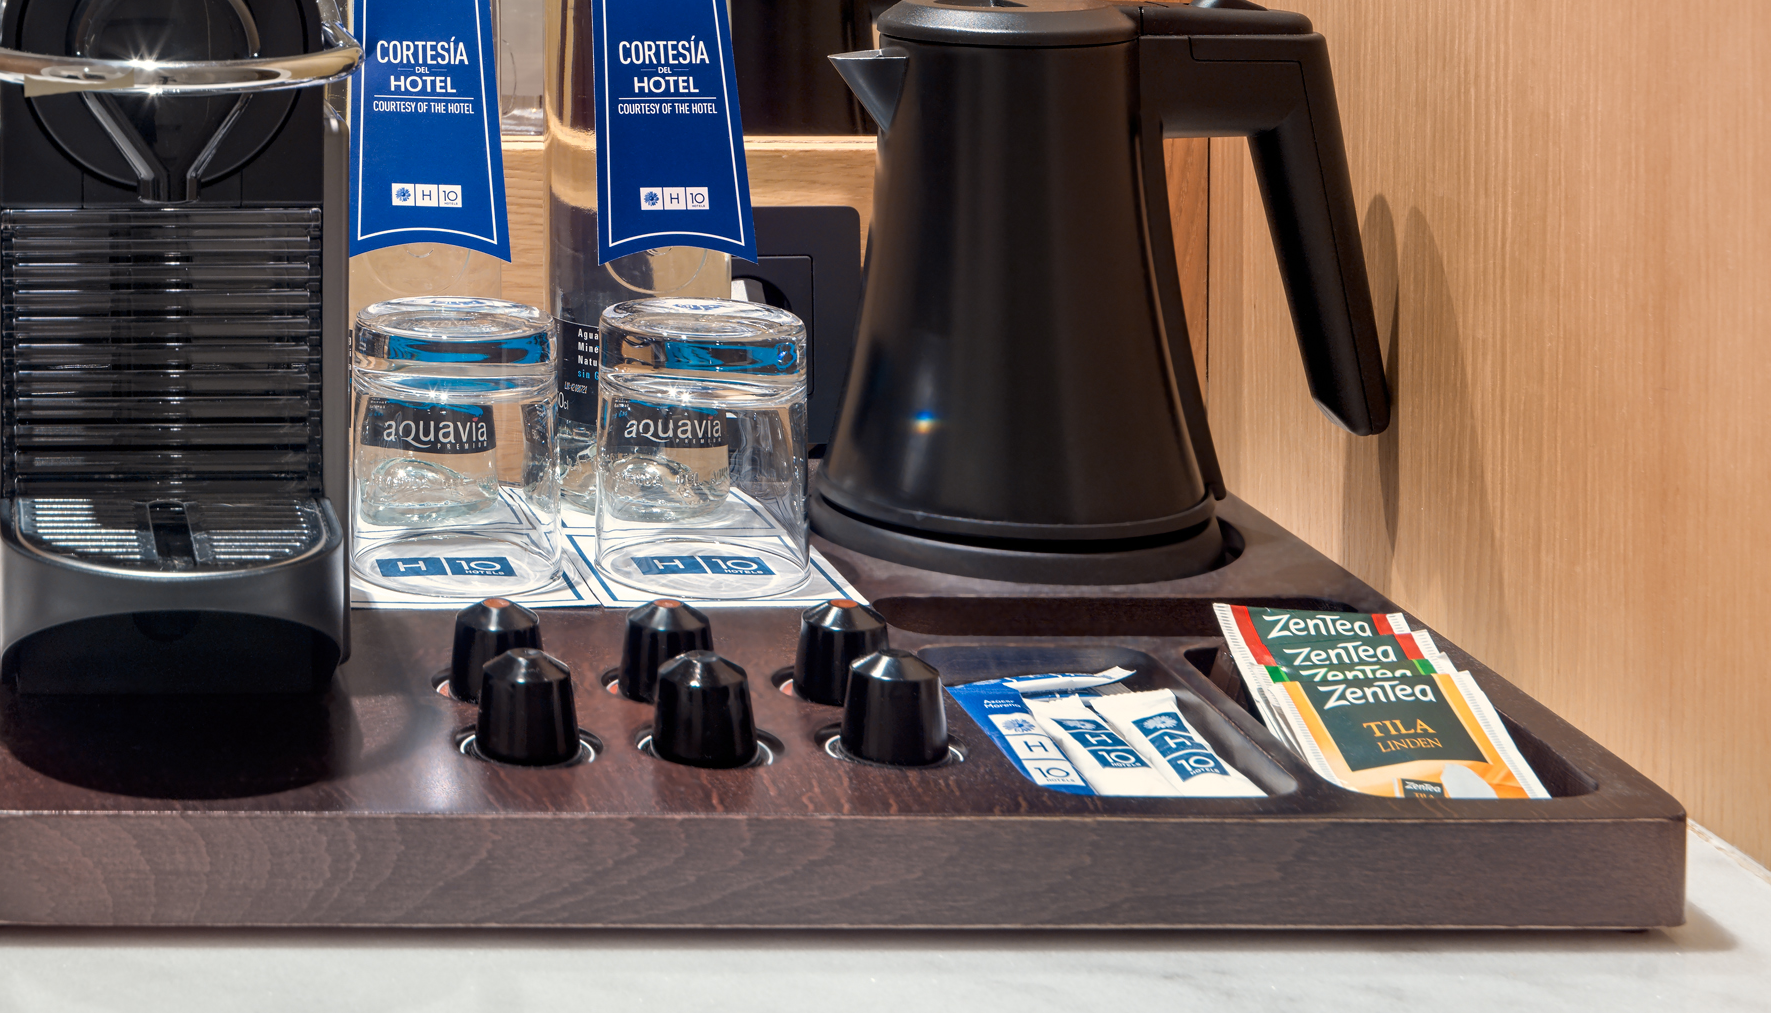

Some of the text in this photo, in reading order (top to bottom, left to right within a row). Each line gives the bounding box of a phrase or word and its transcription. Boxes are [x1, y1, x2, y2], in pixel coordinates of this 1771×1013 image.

[376, 36, 469, 65] CORTESÍA
[618, 35, 710, 64] CORTESÍA
[390, 75, 457, 93] HOTEL
[633, 76, 700, 93] HOTEL
[373, 100, 475, 115] COURTESY OF THE HOTEL
[618, 103, 718, 115] COURTESY OF THE HOTEL
[422, 189, 459, 202] H 10
[669, 192, 706, 205] H 10
[577, 328, 599, 341] Agua
[577, 341, 599, 354] Mine
[577, 354, 598, 367] Natu
[577, 369, 591, 379] sin
[396, 560, 502, 572] H 10
[653, 558, 758, 571] H 10
[1262, 614, 1373, 639] ZenTea
[1283, 641, 1398, 666] ZenTea
[1317, 680, 1437, 710] ZenTea
[1362, 718, 1437, 737] TILA
[1085, 733, 1113, 745] H
[1164, 735, 1192, 749] H
[1377, 737, 1443, 753] LINDEN
[1023, 740, 1049, 753] H
[1098, 751, 1136, 764] 10
[1177, 755, 1215, 771] 10
[1033, 767, 1070, 779] 10
